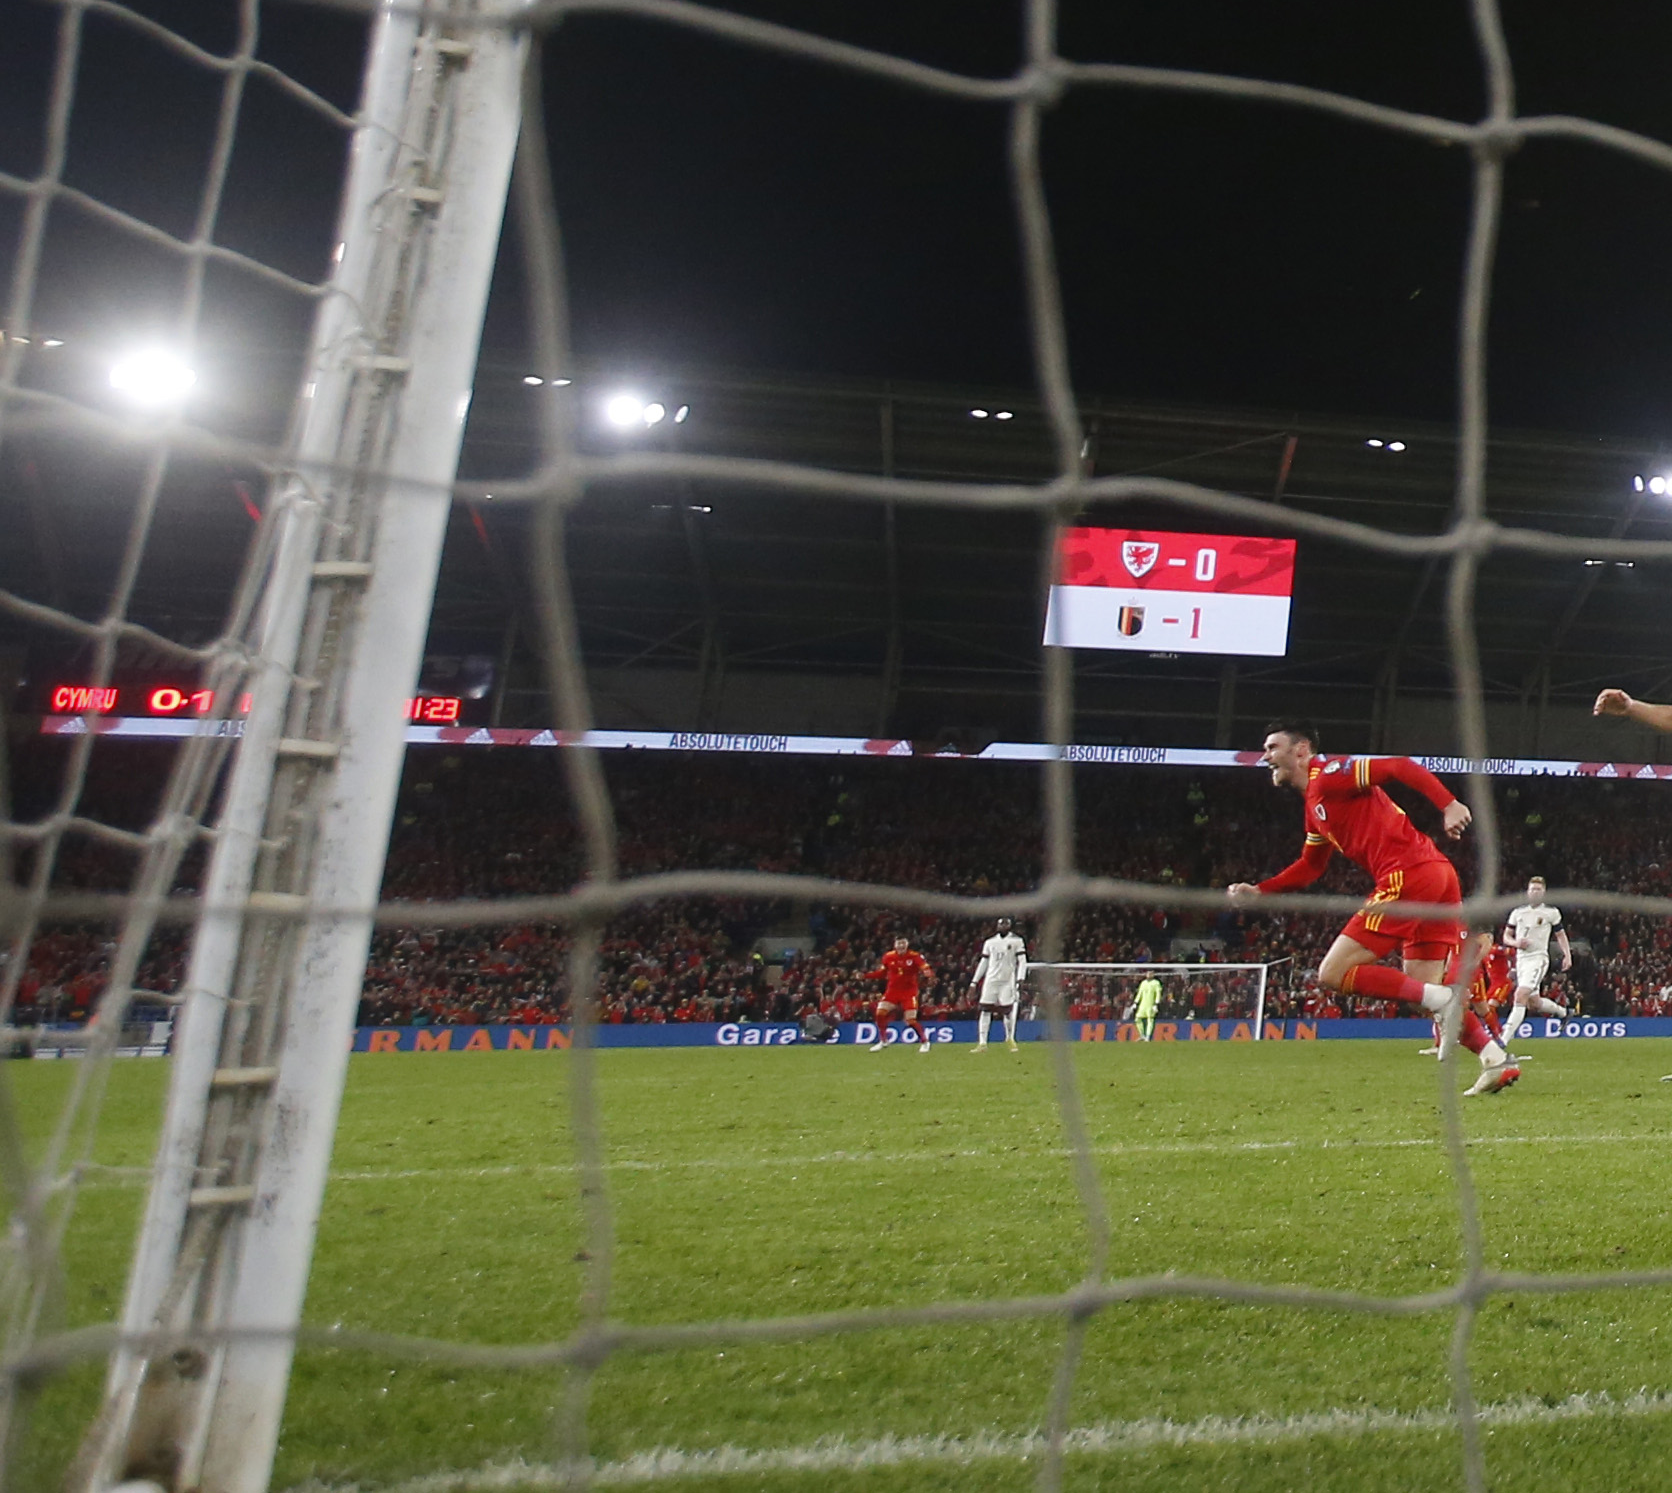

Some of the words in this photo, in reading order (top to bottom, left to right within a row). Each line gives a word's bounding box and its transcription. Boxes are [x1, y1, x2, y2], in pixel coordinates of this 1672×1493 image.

[1195, 548, 1218, 582] 0
[1190, 607, 1202, 639] 1
[55, 687, 118, 710] CYMRU
[669, 733, 787, 751] ABSOLUTETOUCH
[1060, 744, 1166, 763] ABSOLUTETOUCH
[716, 1023, 840, 1045] Garae
[1545, 1018, 1627, 1038] Doors
[347, 1028, 574, 1053] RMANN
